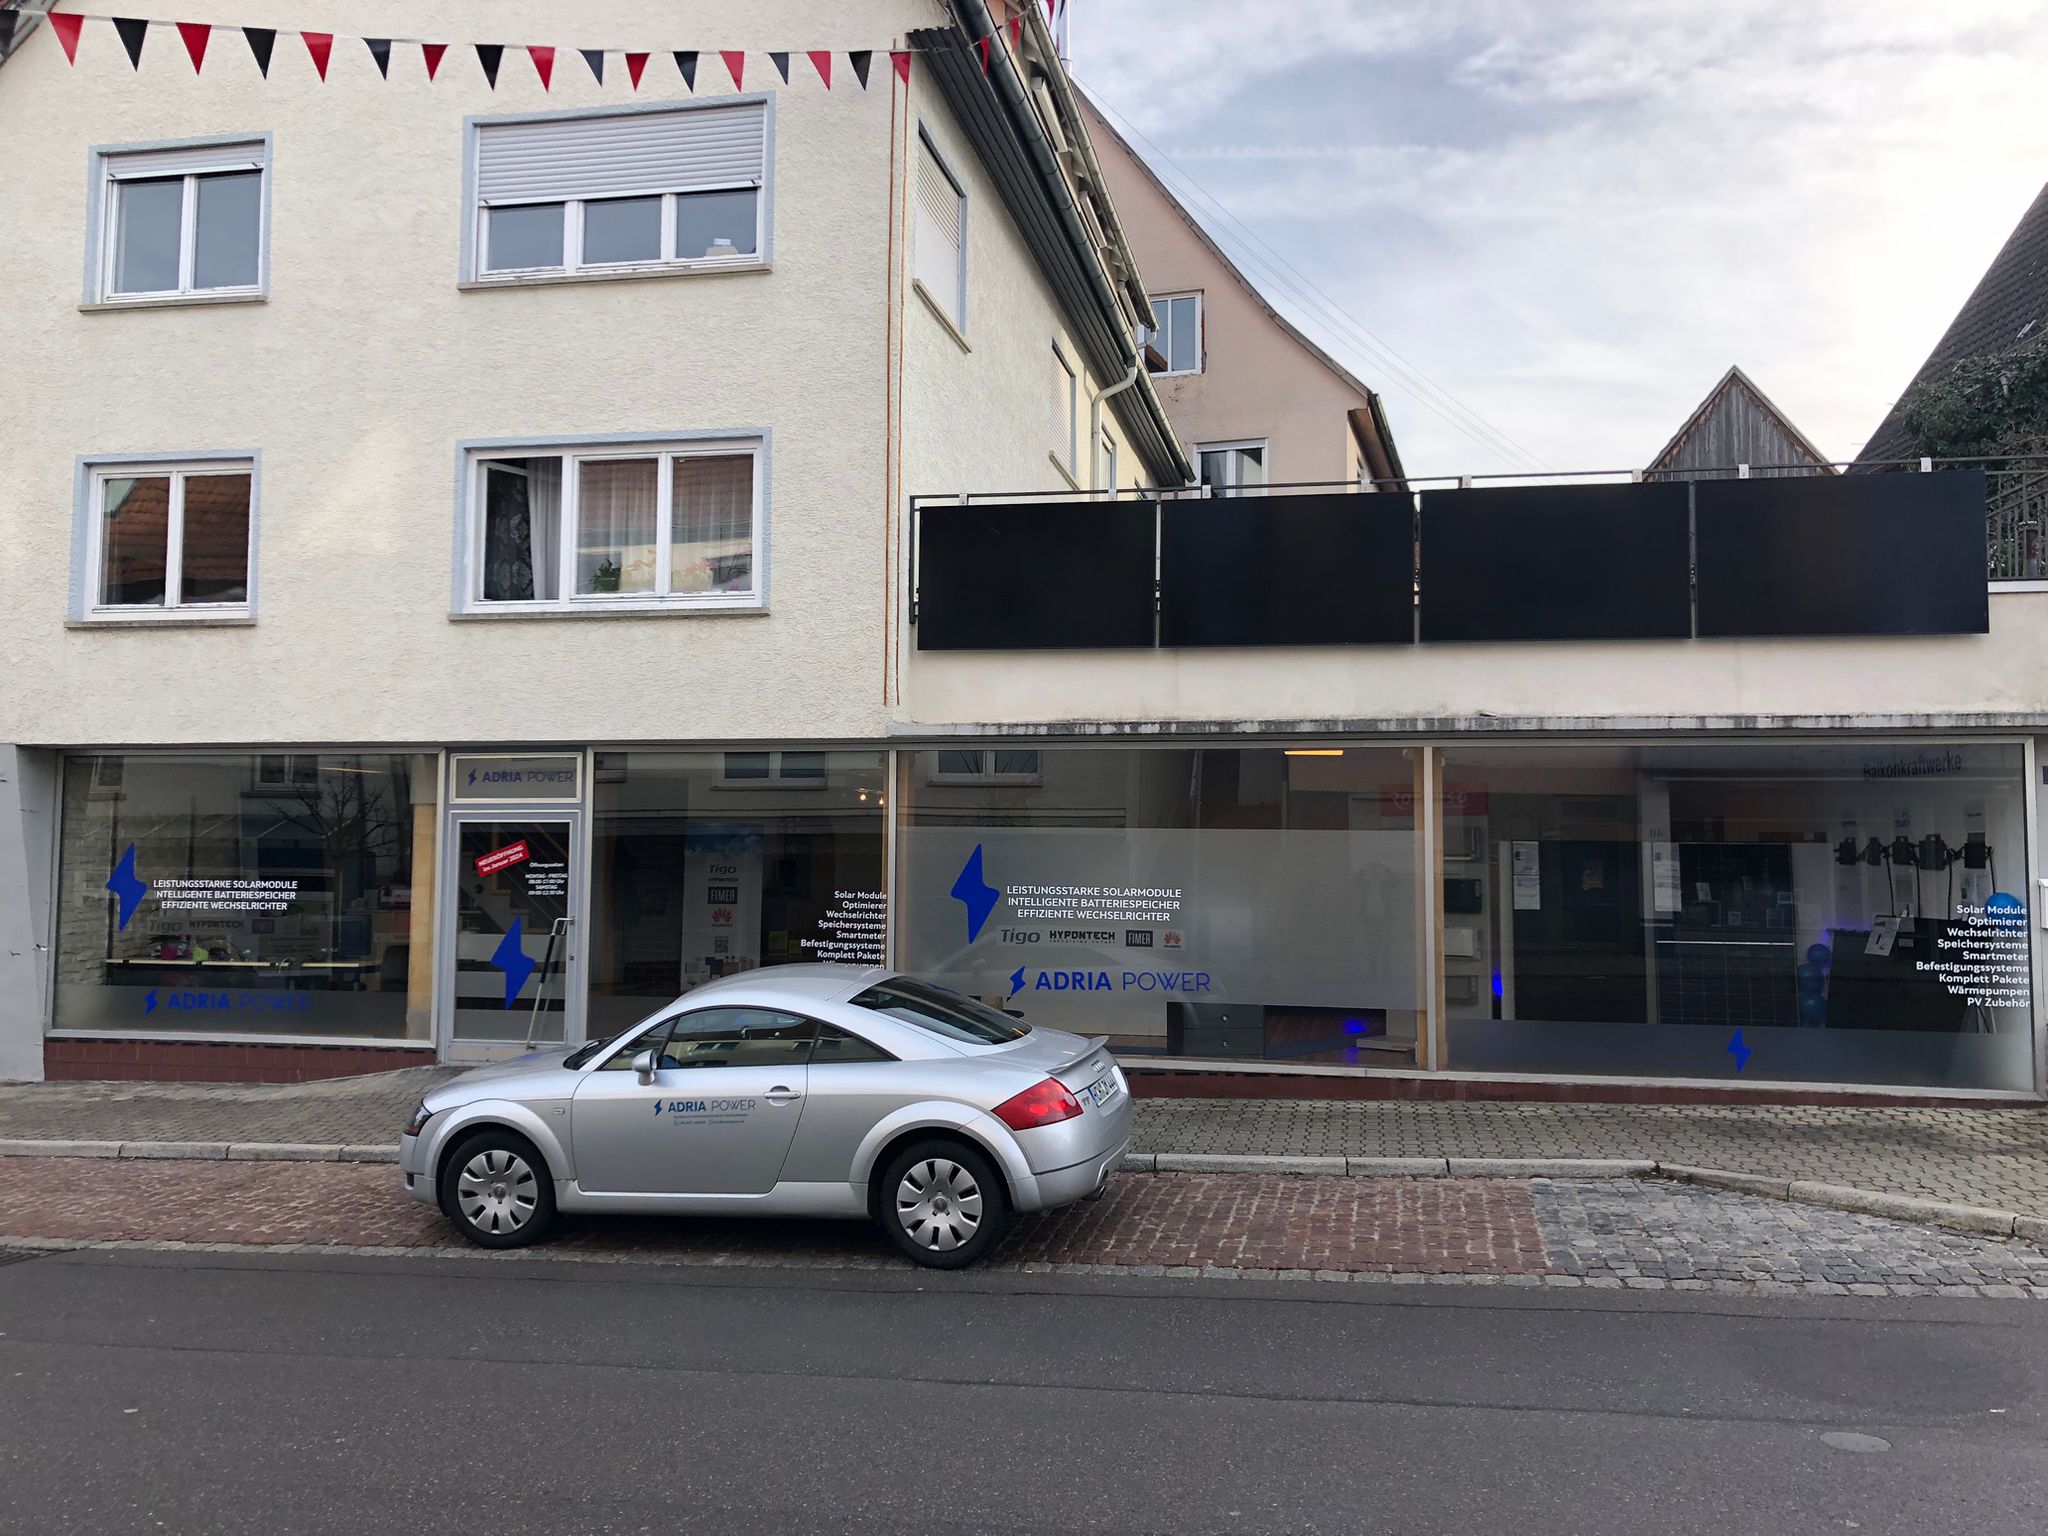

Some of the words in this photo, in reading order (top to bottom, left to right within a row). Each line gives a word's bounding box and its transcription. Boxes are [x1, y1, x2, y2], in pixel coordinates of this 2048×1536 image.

[482, 771, 523, 783] ADRIA
[527, 771, 574, 783] POWER
[708, 863, 736, 875] Tigo
[153, 879, 231, 889] LEISTUNGSSTARKE
[233, 880, 298, 889] SOLARMODULE
[214, 891, 296, 900] BATTERIESPEICHER
[711, 888, 735, 902] FIMER
[834, 890, 855, 899] Solar
[857, 891, 887, 899] Module
[1007, 885, 1100, 896] LEISTUNGSSTARKE
[1103, 887, 1182, 898] SOLARMODULE
[161, 901, 209, 910] EFFIZIENTE
[210, 902, 288, 911] WECHSELRICHTER
[842, 901, 887, 910] Optimierer
[1008, 897, 1078, 907] INTELLIGENTE
[1080, 898, 1180, 910] BATTERIESPEICHER
[826, 910, 886, 919] Wechselrichter
[1017, 909, 1074, 919] EFFIZIENTE
[1076, 910, 1170, 921] WECHSELRICHTER
[1957, 905, 1984, 914] Solar
[1987, 905, 2027, 915] Module
[818, 920, 886, 930] Speichersysteme
[1968, 916, 2027, 927] Optimierer
[836, 931, 886, 939] Smartmeter
[1001, 927, 1040, 945] Tigo
[1127, 931, 1151, 946] FIMER
[1947, 928, 2028, 938] Wechselrichter
[800, 939, 885, 950] Befestigungssysteme
[1938, 939, 2028, 950] Speichersysteme
[817, 950, 855, 960] Komplett
[857, 951, 885, 960] Pakete
[1963, 951, 2028, 961] Smartmeter
[1916, 961, 2029, 973] Befestigungssysteme
[1035, 971, 1112, 991] ADRIA
[1122, 972, 1210, 992] POWER
[1939, 973, 1990, 984] Komplett
[1992, 975, 2029, 984] Pakete
[1947, 985, 2030, 997] Wärmepumpen
[167, 992, 231, 1010] ADRIA
[239, 992, 314, 1012] POWER
[1967, 997, 1982, 1006] PV
[1985, 997, 2030, 1007] Zubehör
[668, 1101, 707, 1113] ADRIA
[711, 1099, 756, 1112] POWER
